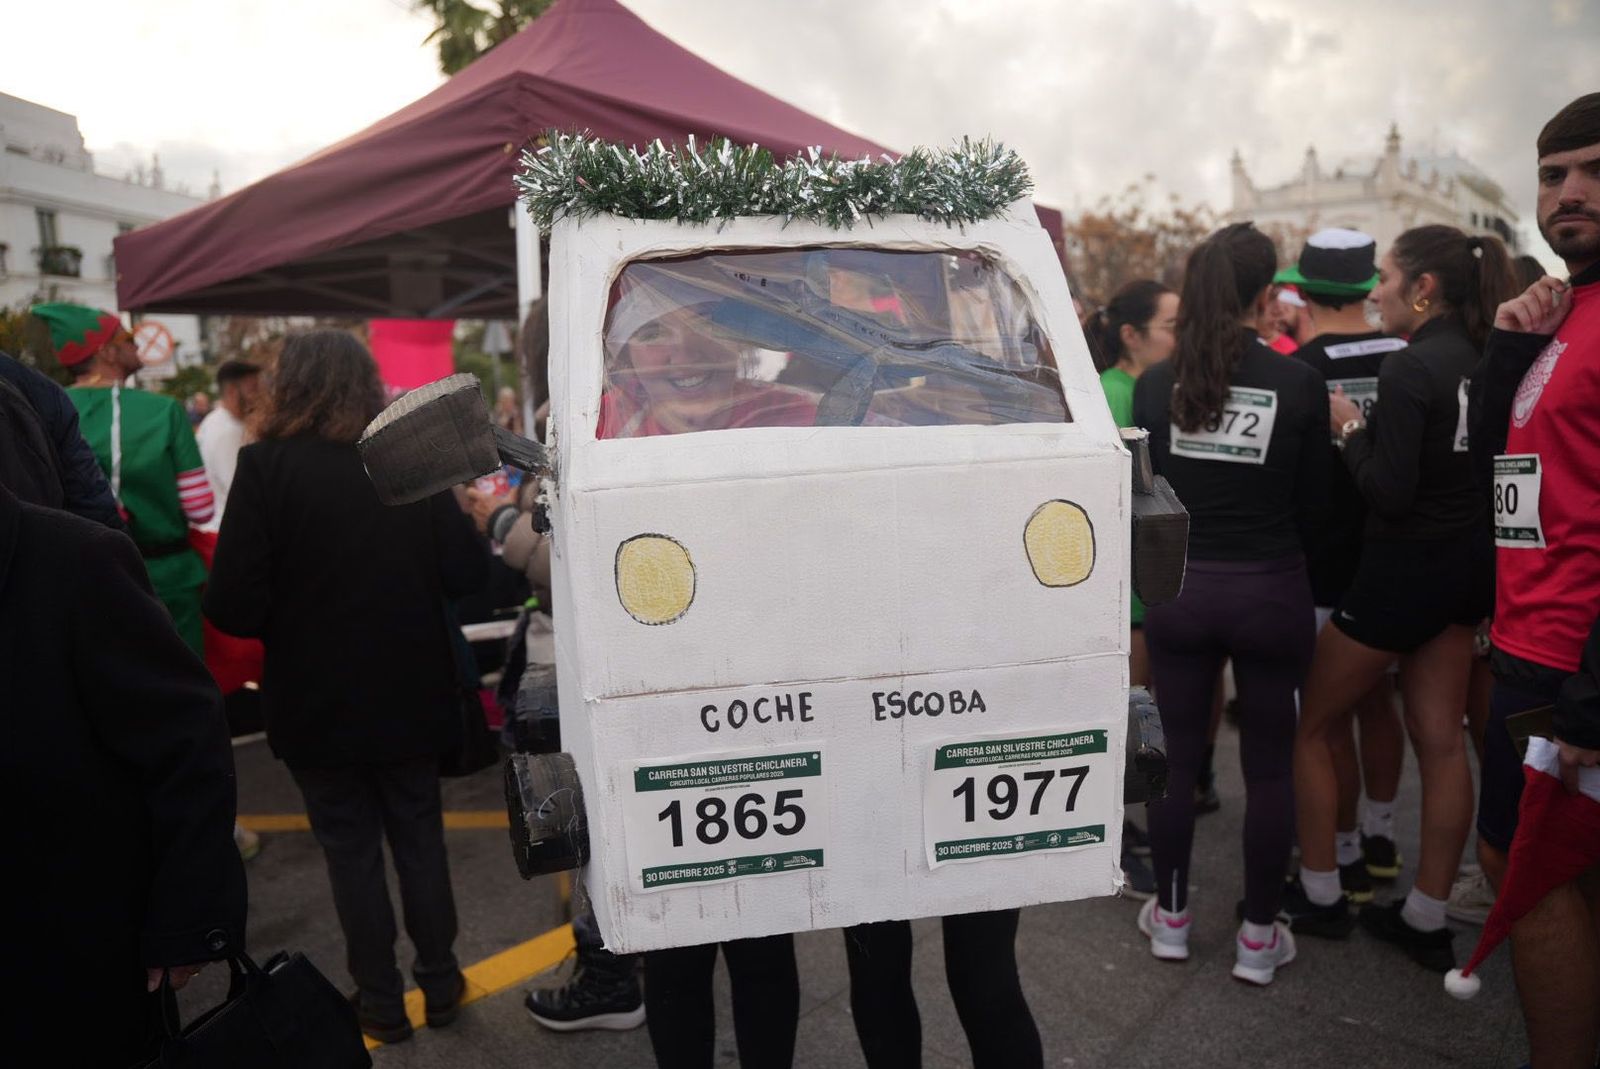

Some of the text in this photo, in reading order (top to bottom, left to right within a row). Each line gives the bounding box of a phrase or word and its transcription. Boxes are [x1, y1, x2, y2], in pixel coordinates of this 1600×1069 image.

[1495, 483, 1518, 515] 80
[700, 689, 986, 733] COCHE ESCOBA
[946, 734, 1094, 758] CARRERA SAN SILVESTRE CHICLANERA
[965, 756, 988, 765] CIRCUITO
[988, 755, 1004, 763] LOCAL
[1004, 753, 1030, 762] CARRERAS
[1031, 750, 1060, 760] POPULARES
[648, 758, 808, 781] CARRERA SAN SILVESTRE CHICLANERA
[670, 770, 784, 787] CIRCUITO LOCAL CARRERAS POPULARES 2025
[953, 765, 1090, 823] 1977
[658, 789, 806, 847] 1865
[938, 845, 949, 856] 30
[950, 842, 991, 855] DICIEMBRE
[992, 840, 1013, 850] 2025
[646, 870, 658, 882] 30
[658, 868, 702, 881] DICIEMBRE
[703, 866, 725, 876] 2025
